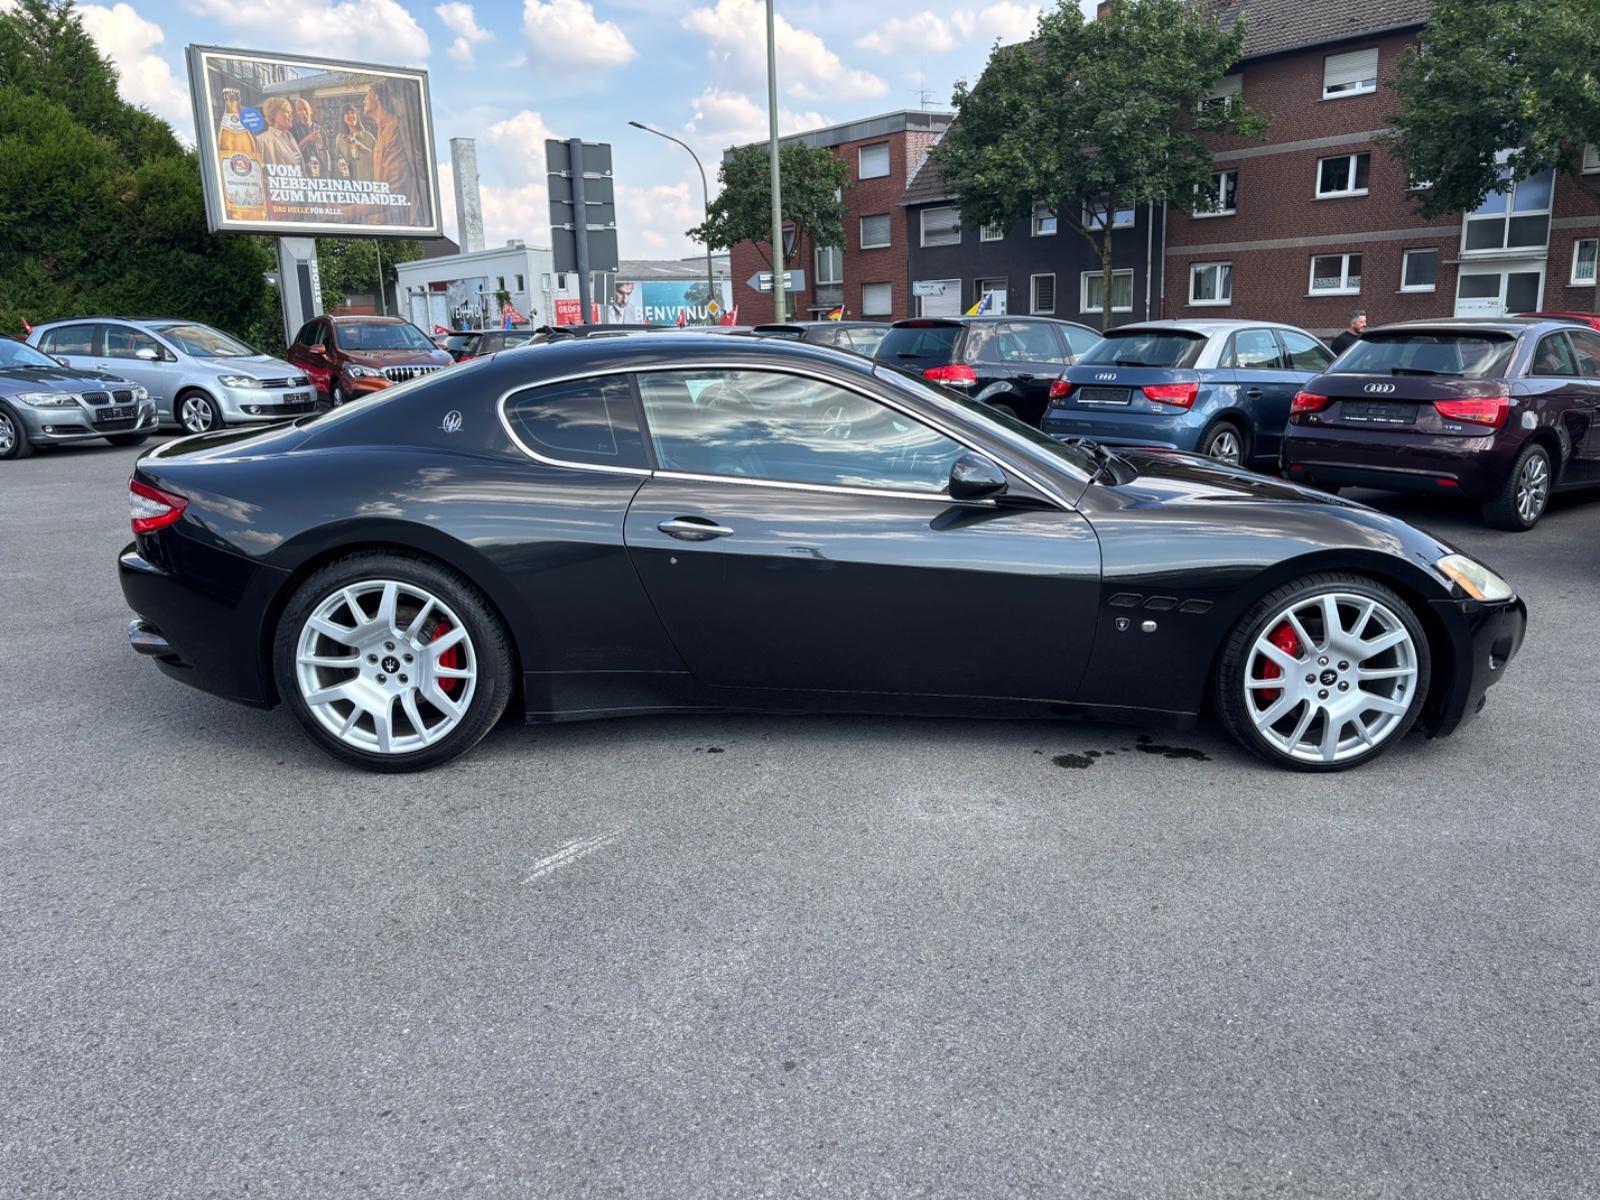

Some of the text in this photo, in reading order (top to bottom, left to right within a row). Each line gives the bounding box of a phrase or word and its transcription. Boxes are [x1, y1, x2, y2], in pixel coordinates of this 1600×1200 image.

[266, 163, 302, 177] VOM
[268, 176, 391, 194] NEBENEINANDER
[270, 189, 411, 206] ZUM MITEINANDER.
[272, 205, 287, 214] DAS
